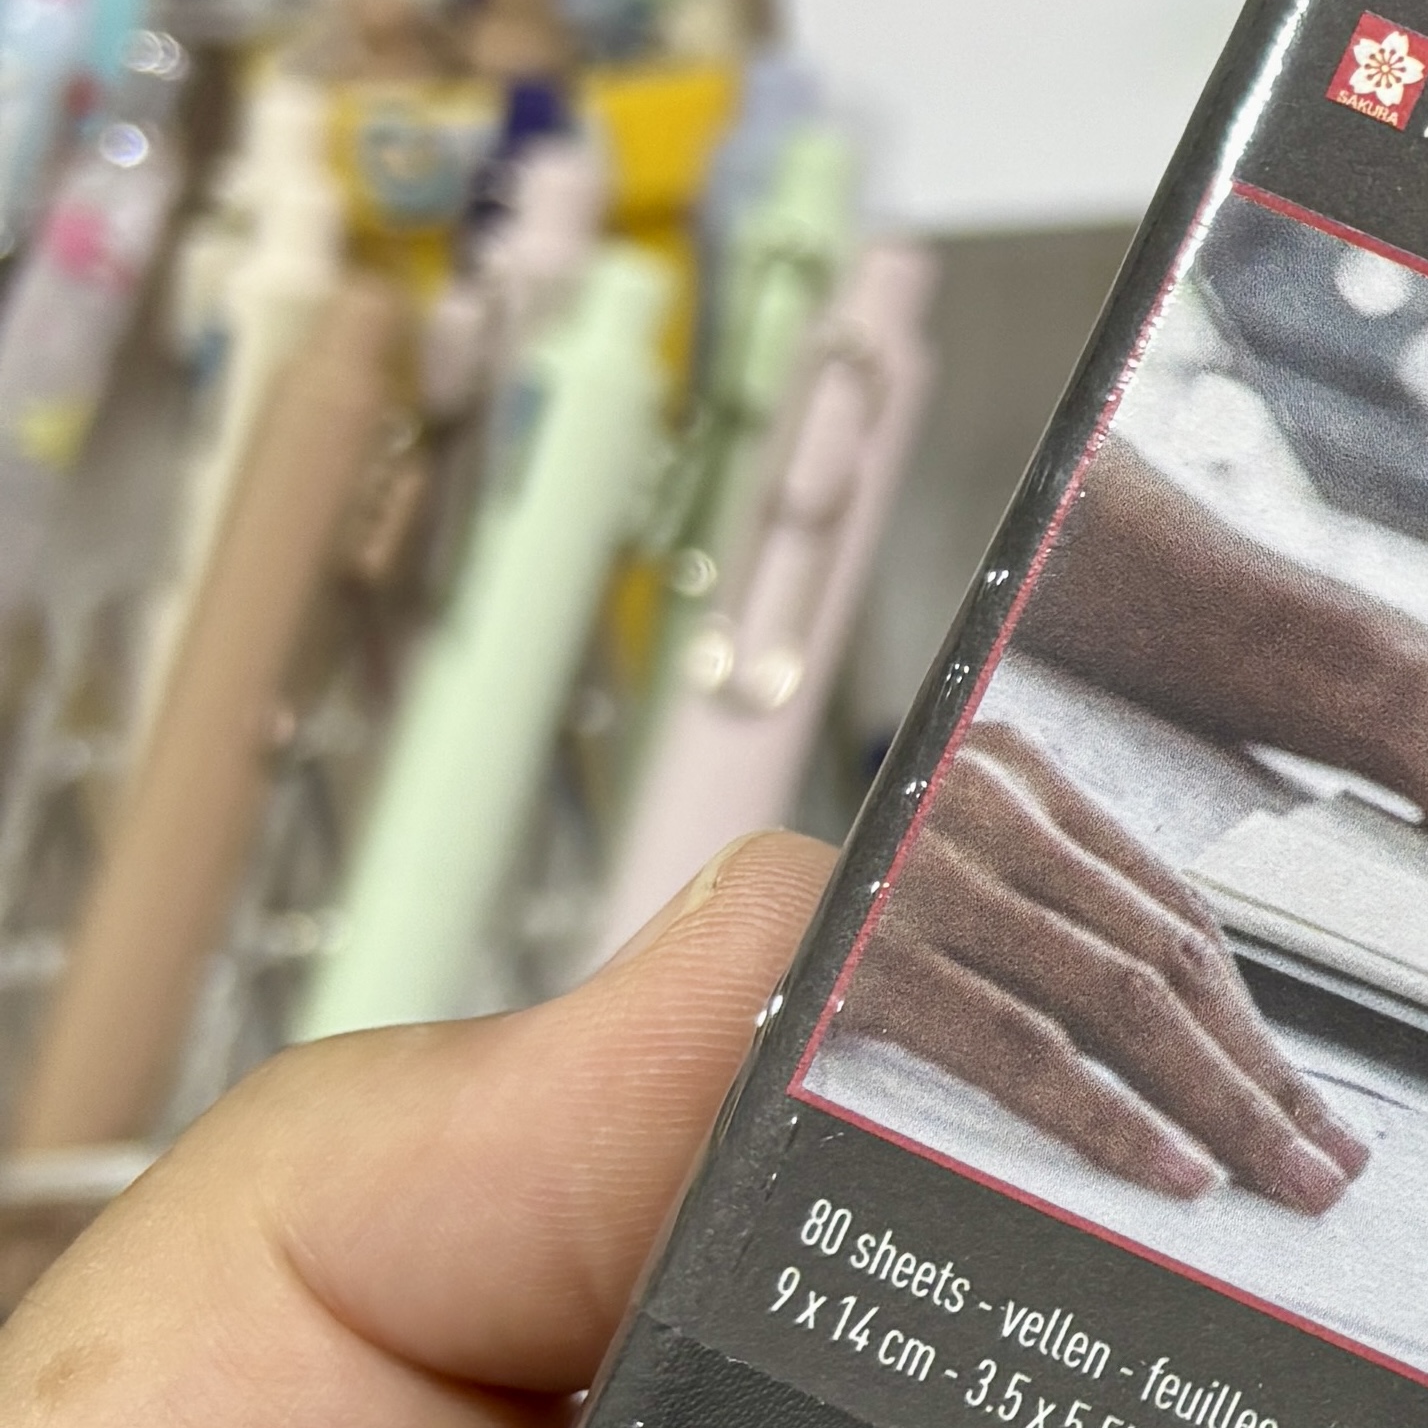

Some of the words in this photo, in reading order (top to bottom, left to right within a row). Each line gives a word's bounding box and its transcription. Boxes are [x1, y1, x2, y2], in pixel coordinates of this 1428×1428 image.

[1335, 88, 1402, 127] SAKURA
[770, 1265, 801, 1313] 9
[794, 1289, 828, 1330] x
[830, 1295, 880, 1353] 14
[877, 1328, 937, 1382] cm
[964, 1358, 1032, 1422] 3.5
[800, 1198, 853, 1256] 80
[849, 1229, 972, 1313] sheets
[1001, 1300, 1112, 1380] vellen
